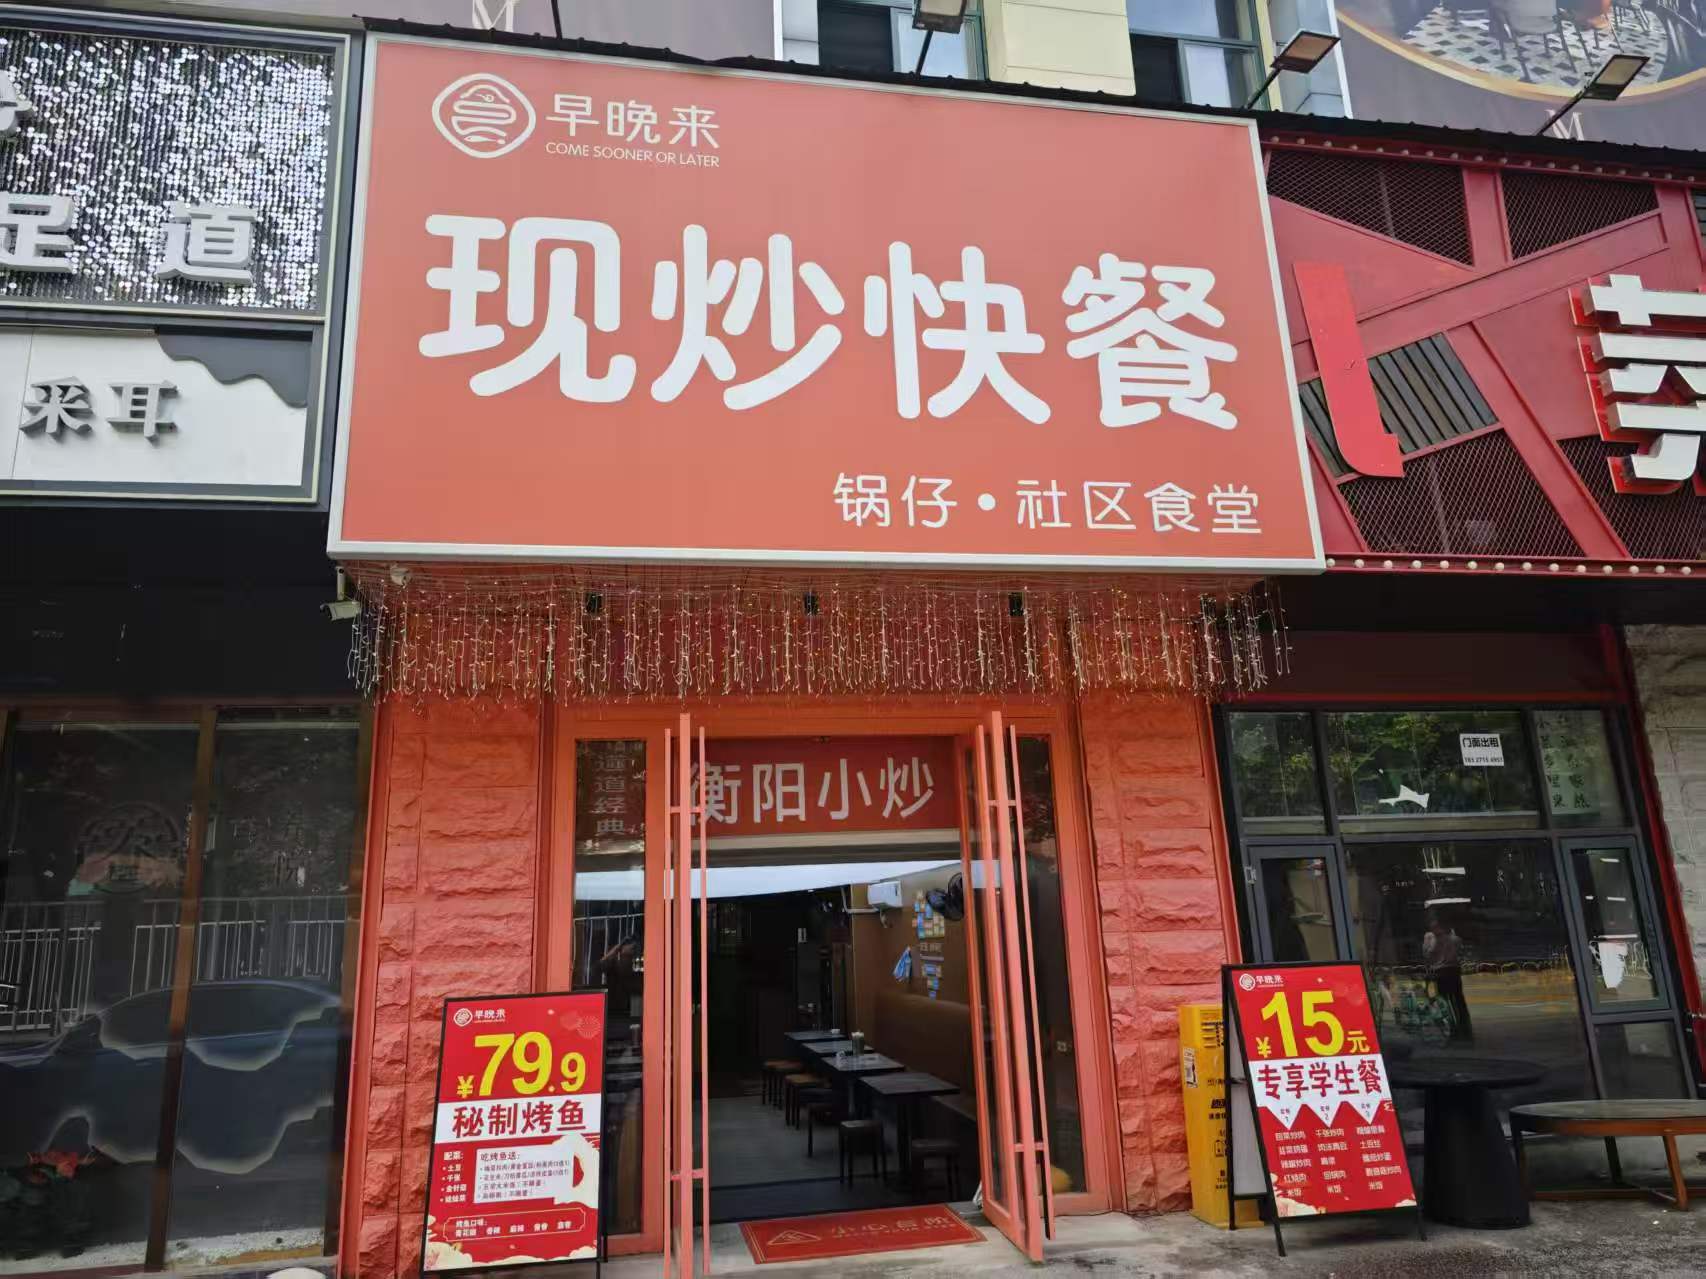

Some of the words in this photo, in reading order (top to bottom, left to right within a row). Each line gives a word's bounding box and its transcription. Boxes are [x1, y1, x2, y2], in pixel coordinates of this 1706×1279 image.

[545, 93, 720, 149] 早晚来
[545, 142, 590, 157] COME
[593, 144, 653, 162] SOONER
[656, 150, 676, 165] OR
[679, 153, 720, 168] LATER
[419, 214, 1239, 431] 现炒快餐
[20, 376, 178, 441] 采耳
[1462, 736, 1499, 748] 门面出租
[691, 757, 935, 826] 衡阳小炒
[1255, 974, 1284, 985] 早晚来
[474, 1008, 506, 1019] 早晚来
[456, 1031, 587, 1098] ¥79.9
[1257, 1059, 1382, 1101] 专享学生餐
[452, 1099, 587, 1138] 秘制烤鱼
